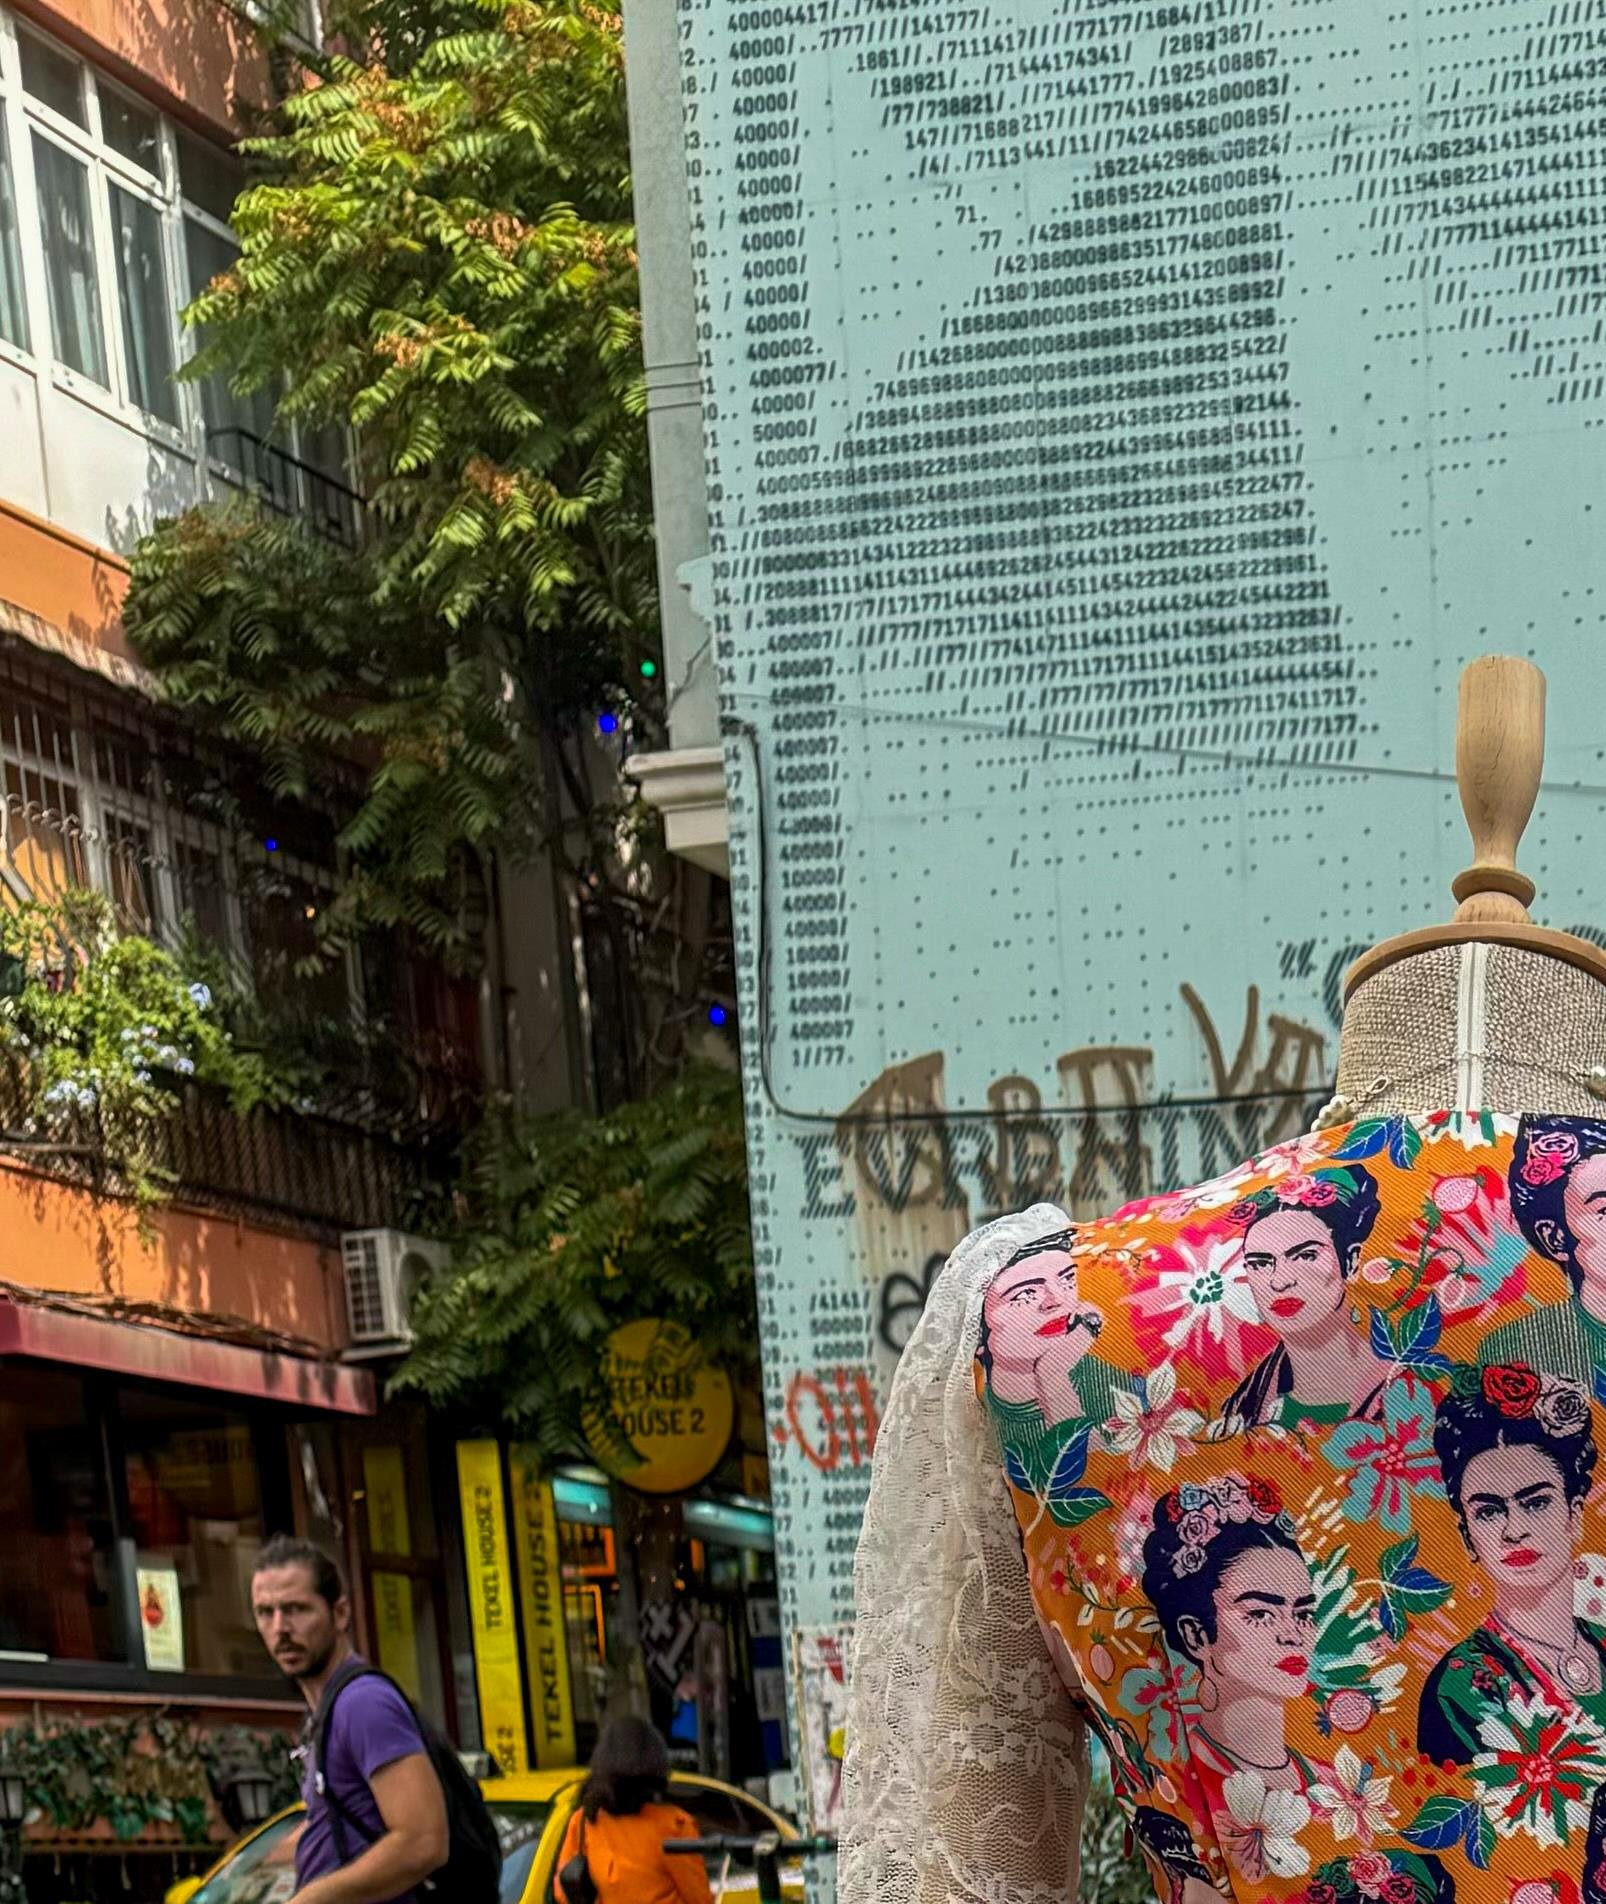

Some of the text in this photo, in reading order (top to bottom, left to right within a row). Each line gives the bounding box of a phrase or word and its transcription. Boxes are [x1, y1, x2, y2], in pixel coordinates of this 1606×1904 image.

[622, 1407, 705, 1437] OUSE 2
[476, 1502, 497, 1567] HOUSE
[482, 1567, 503, 1630] TEKEL
[527, 1512, 553, 1628] HOUSE
[539, 1639, 563, 1744] TEKEL
